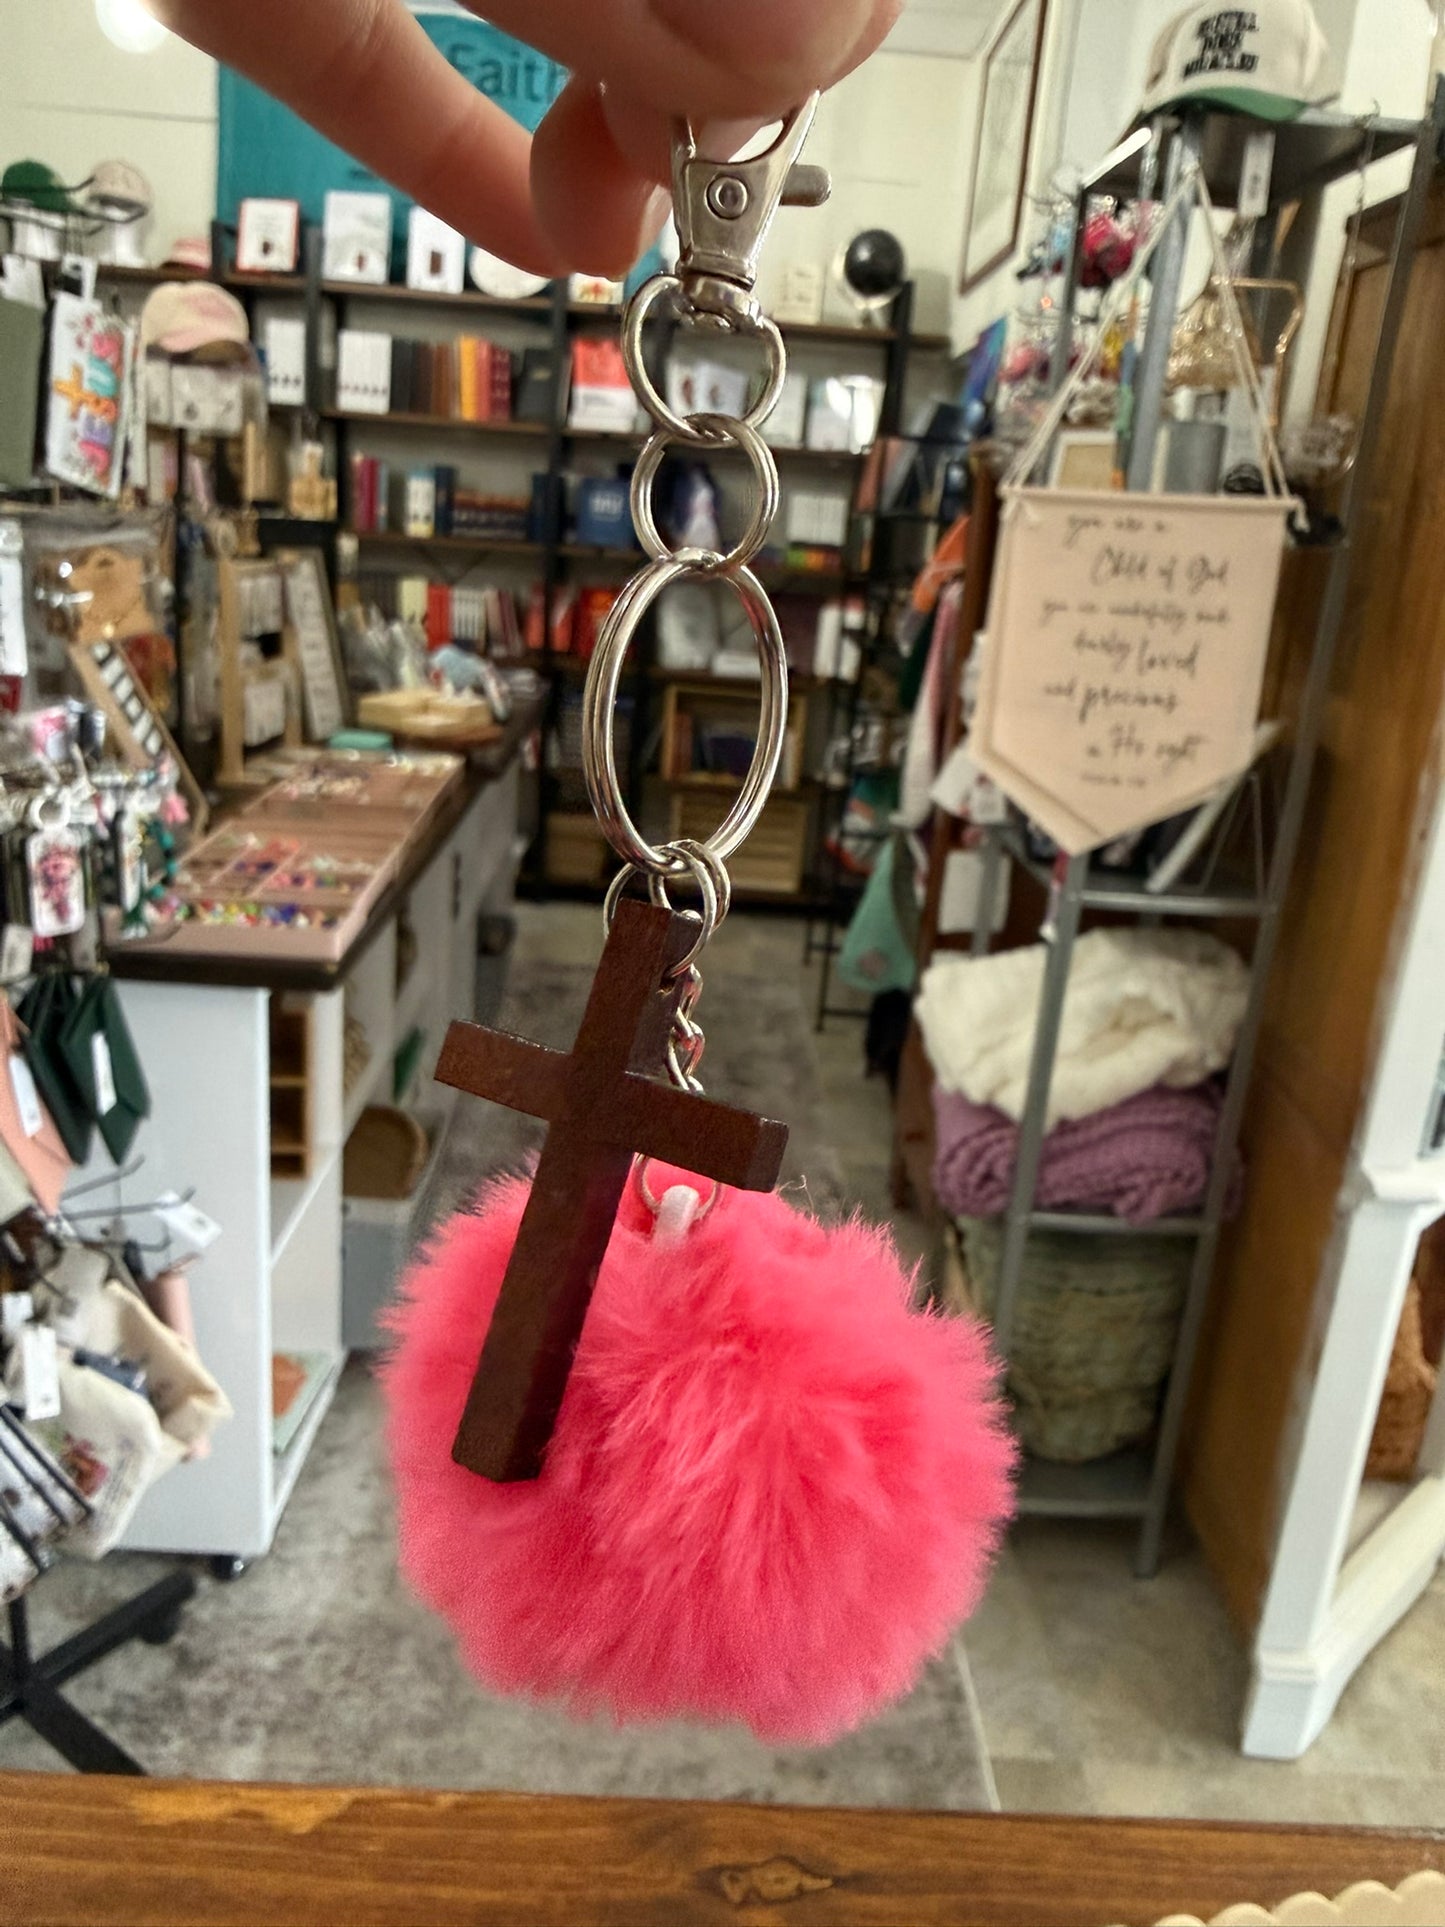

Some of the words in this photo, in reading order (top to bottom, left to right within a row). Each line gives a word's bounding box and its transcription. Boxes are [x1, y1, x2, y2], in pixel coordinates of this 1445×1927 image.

[78, 332, 121, 477] JESUS
[1090, 542, 1150, 587] Child
[1159, 555, 1179, 592] of
[1186, 552, 1231, 595] God
[1136, 634, 1202, 677] loved
[1078, 684, 1178, 724] precious
